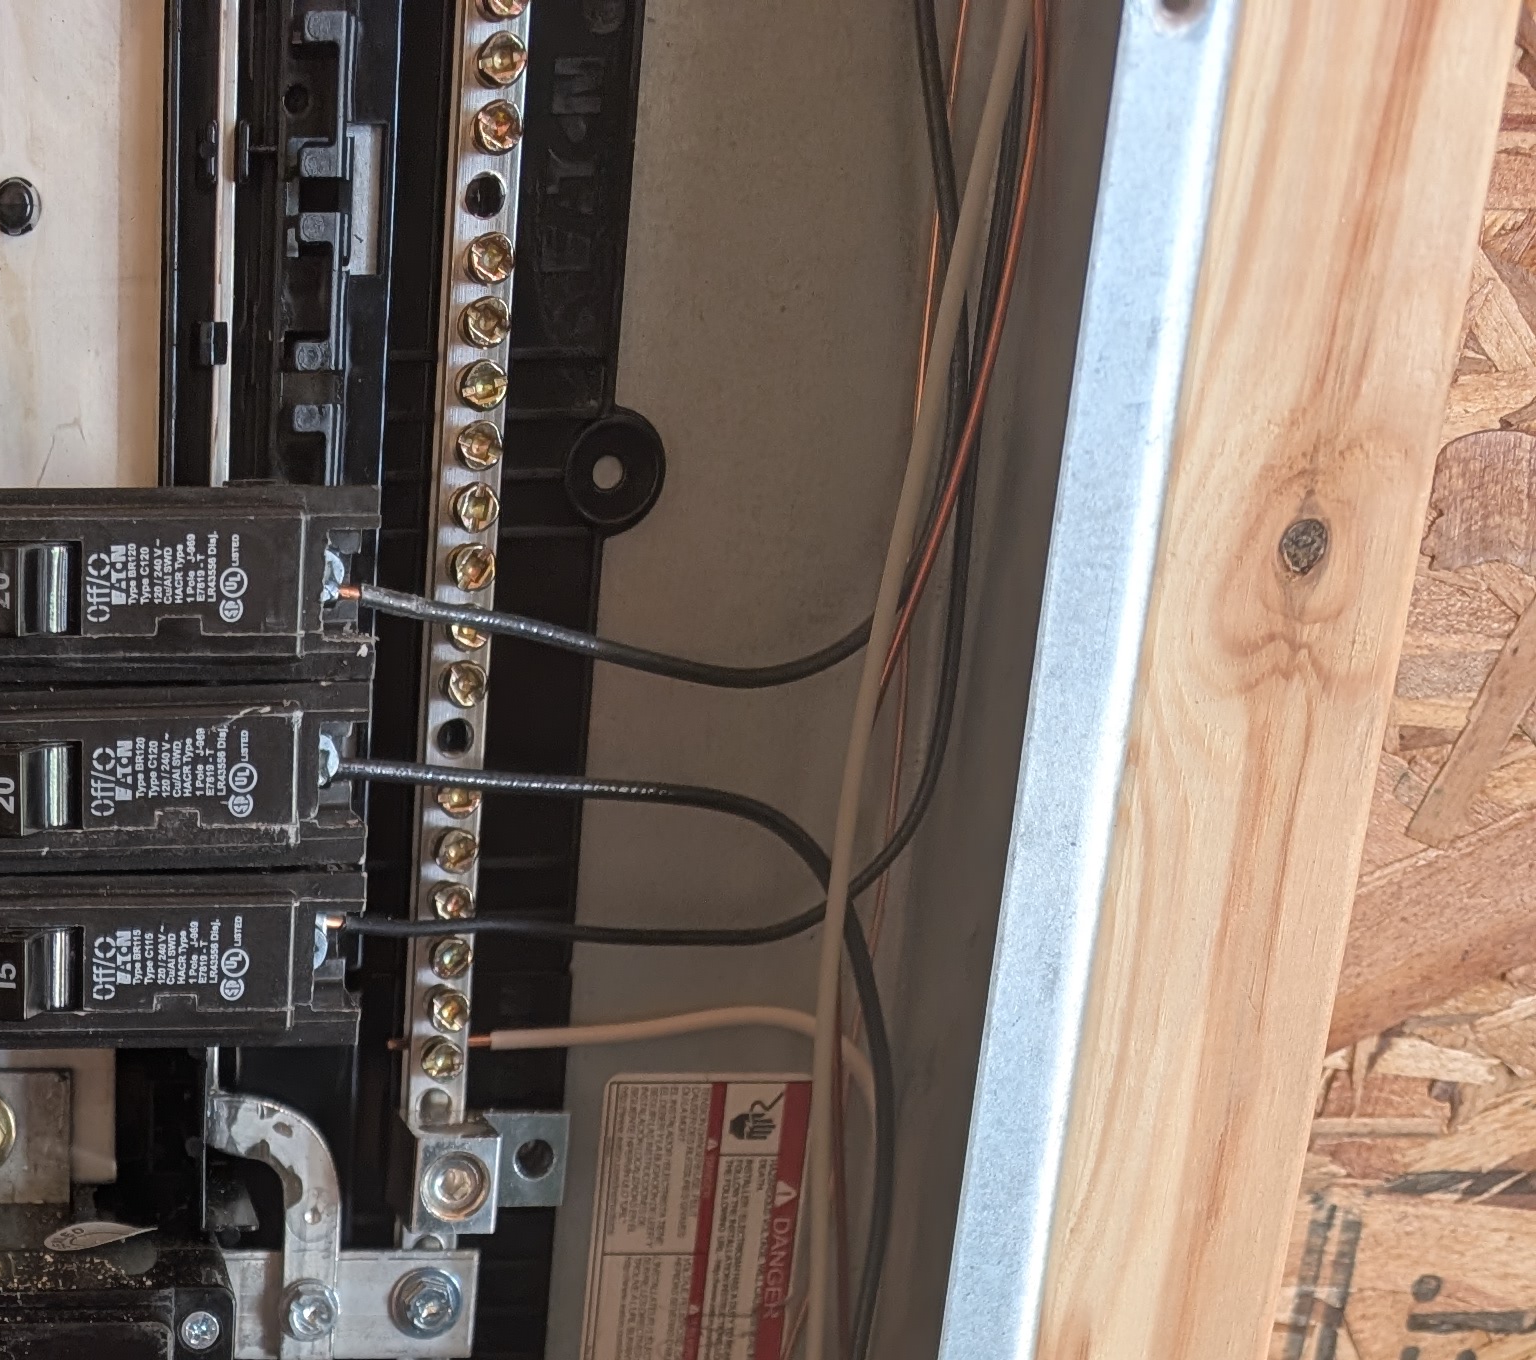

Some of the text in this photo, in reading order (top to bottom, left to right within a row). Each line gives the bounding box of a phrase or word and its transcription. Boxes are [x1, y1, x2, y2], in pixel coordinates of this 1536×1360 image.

[111, 545, 127, 605] EATON
[128, 543, 137, 605] Type BR120
[140, 547, 151, 604] Type C120
[154, 559, 162, 577] 240
[164, 547, 172, 572] SWD
[175, 544, 184, 603] HACR Type
[154, 586, 162, 604] 120
[187, 571, 196, 594] Pole
[173, 741, 181, 766] SWD
[241, 730, 249, 761] LISTED
[116, 740, 133, 801] EATON
[136, 737, 146, 798] Type BR120
[148, 741, 158, 798] Type C120
[162, 752, 170, 797] 120 240
[183, 738, 193, 797] HACR Type
[196, 765, 204, 787] Pole
[168, 933, 176, 956] SWD
[234, 916, 243, 946] LISTED
[116, 930, 132, 985] EATON
[133, 962, 142, 985] Type
[145, 960, 154, 984] Type
[178, 930, 188, 984] HACR Type
[189, 954, 198, 975] Pole
[763, 1217, 792, 1318] DANGER
